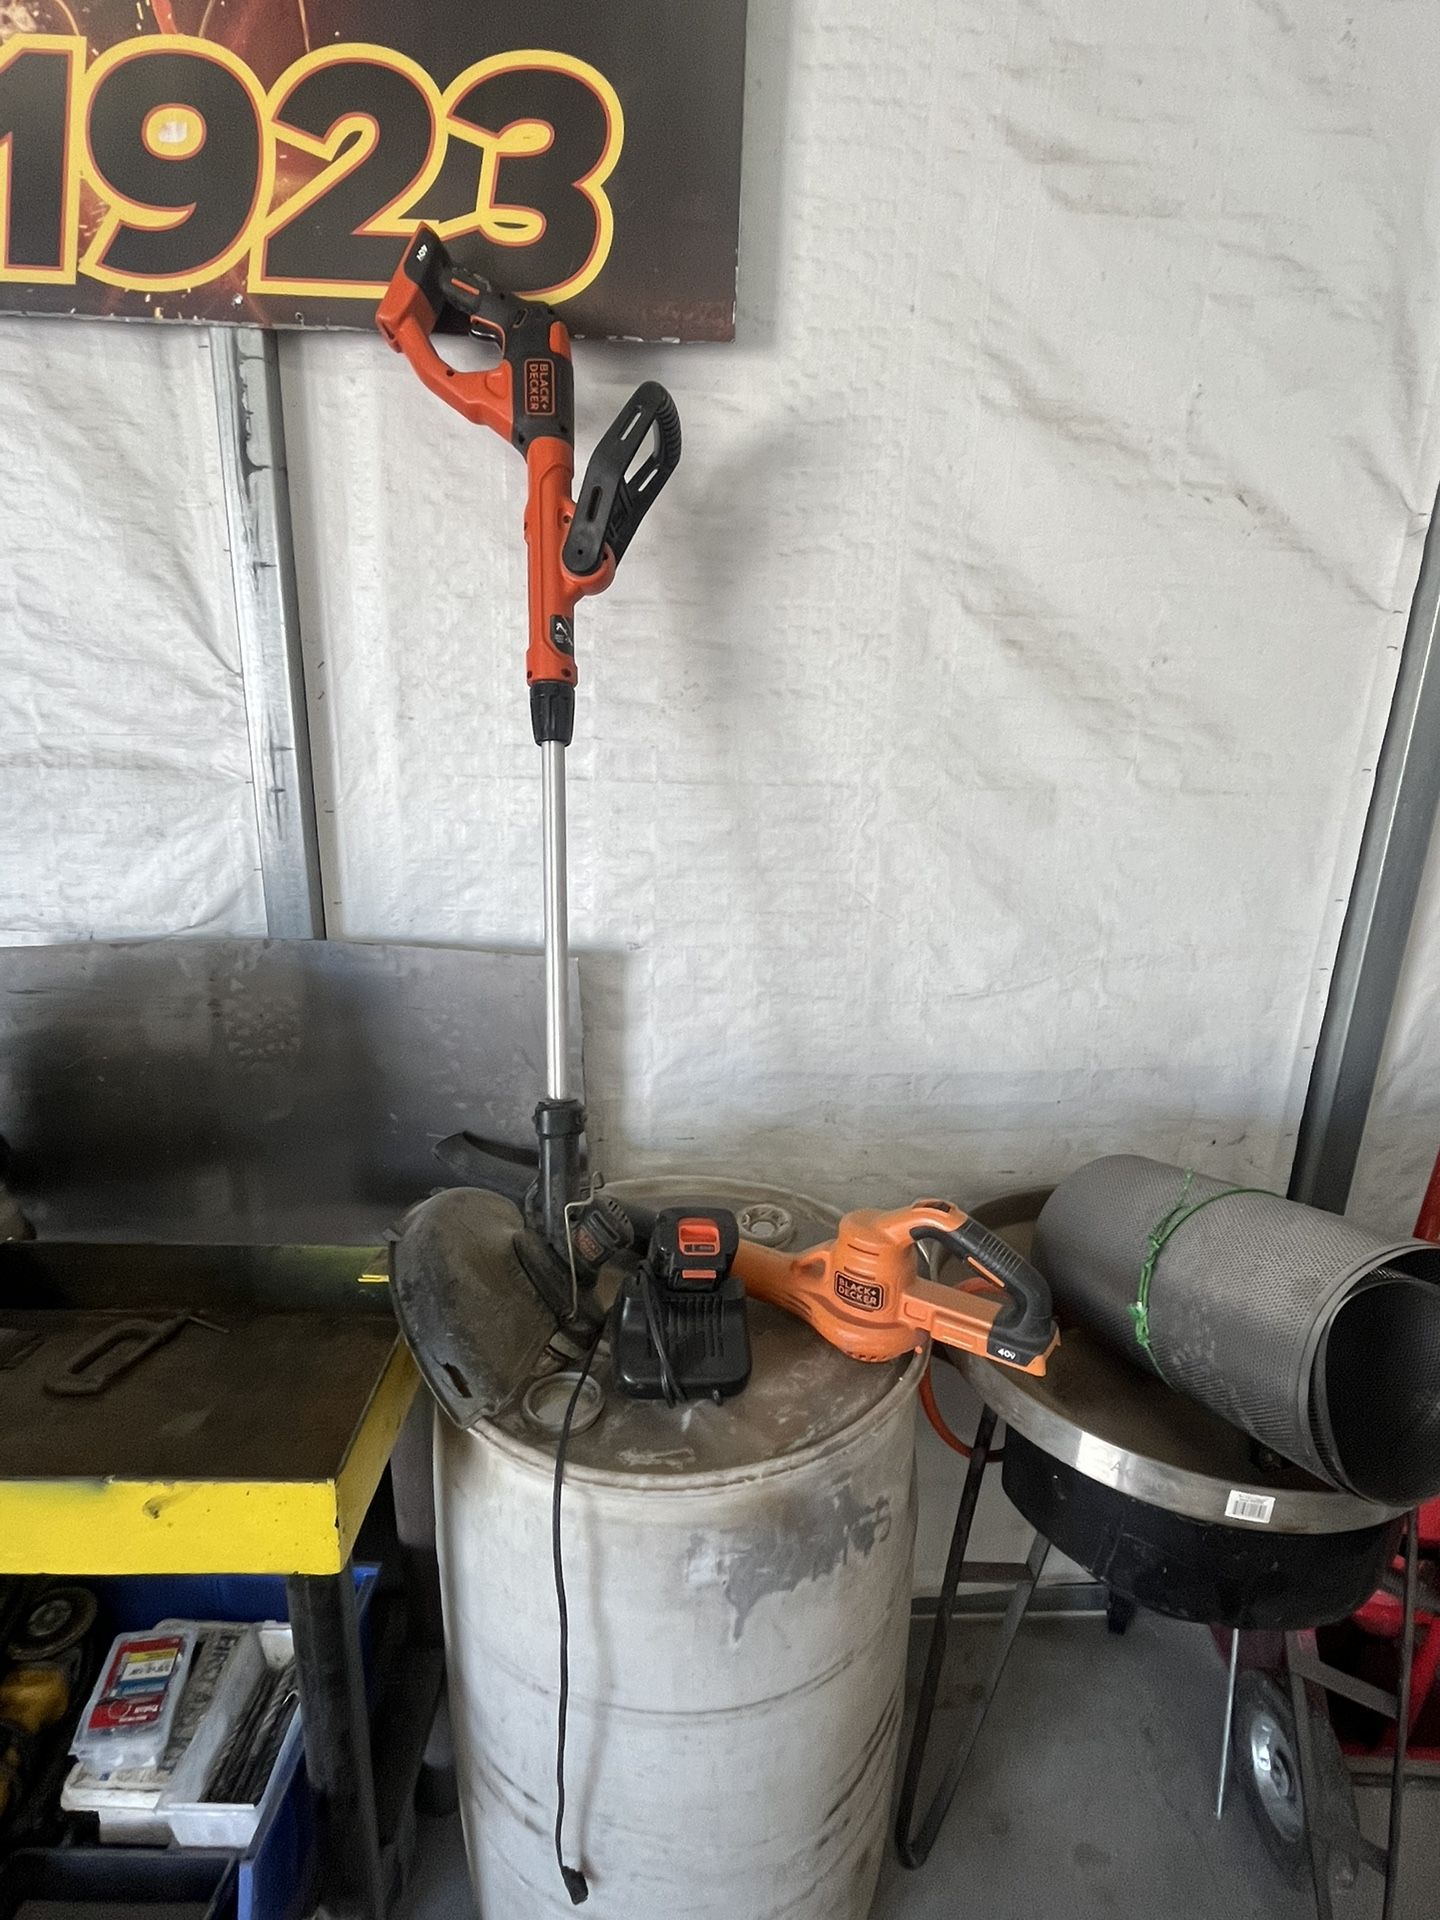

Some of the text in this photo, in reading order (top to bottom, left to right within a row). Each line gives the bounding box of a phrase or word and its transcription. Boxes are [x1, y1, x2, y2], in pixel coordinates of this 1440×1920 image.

[0, 33, 625, 305] 1923
[529, 363, 540, 410] DECKER
[838, 1285, 877, 1306] DECKER
